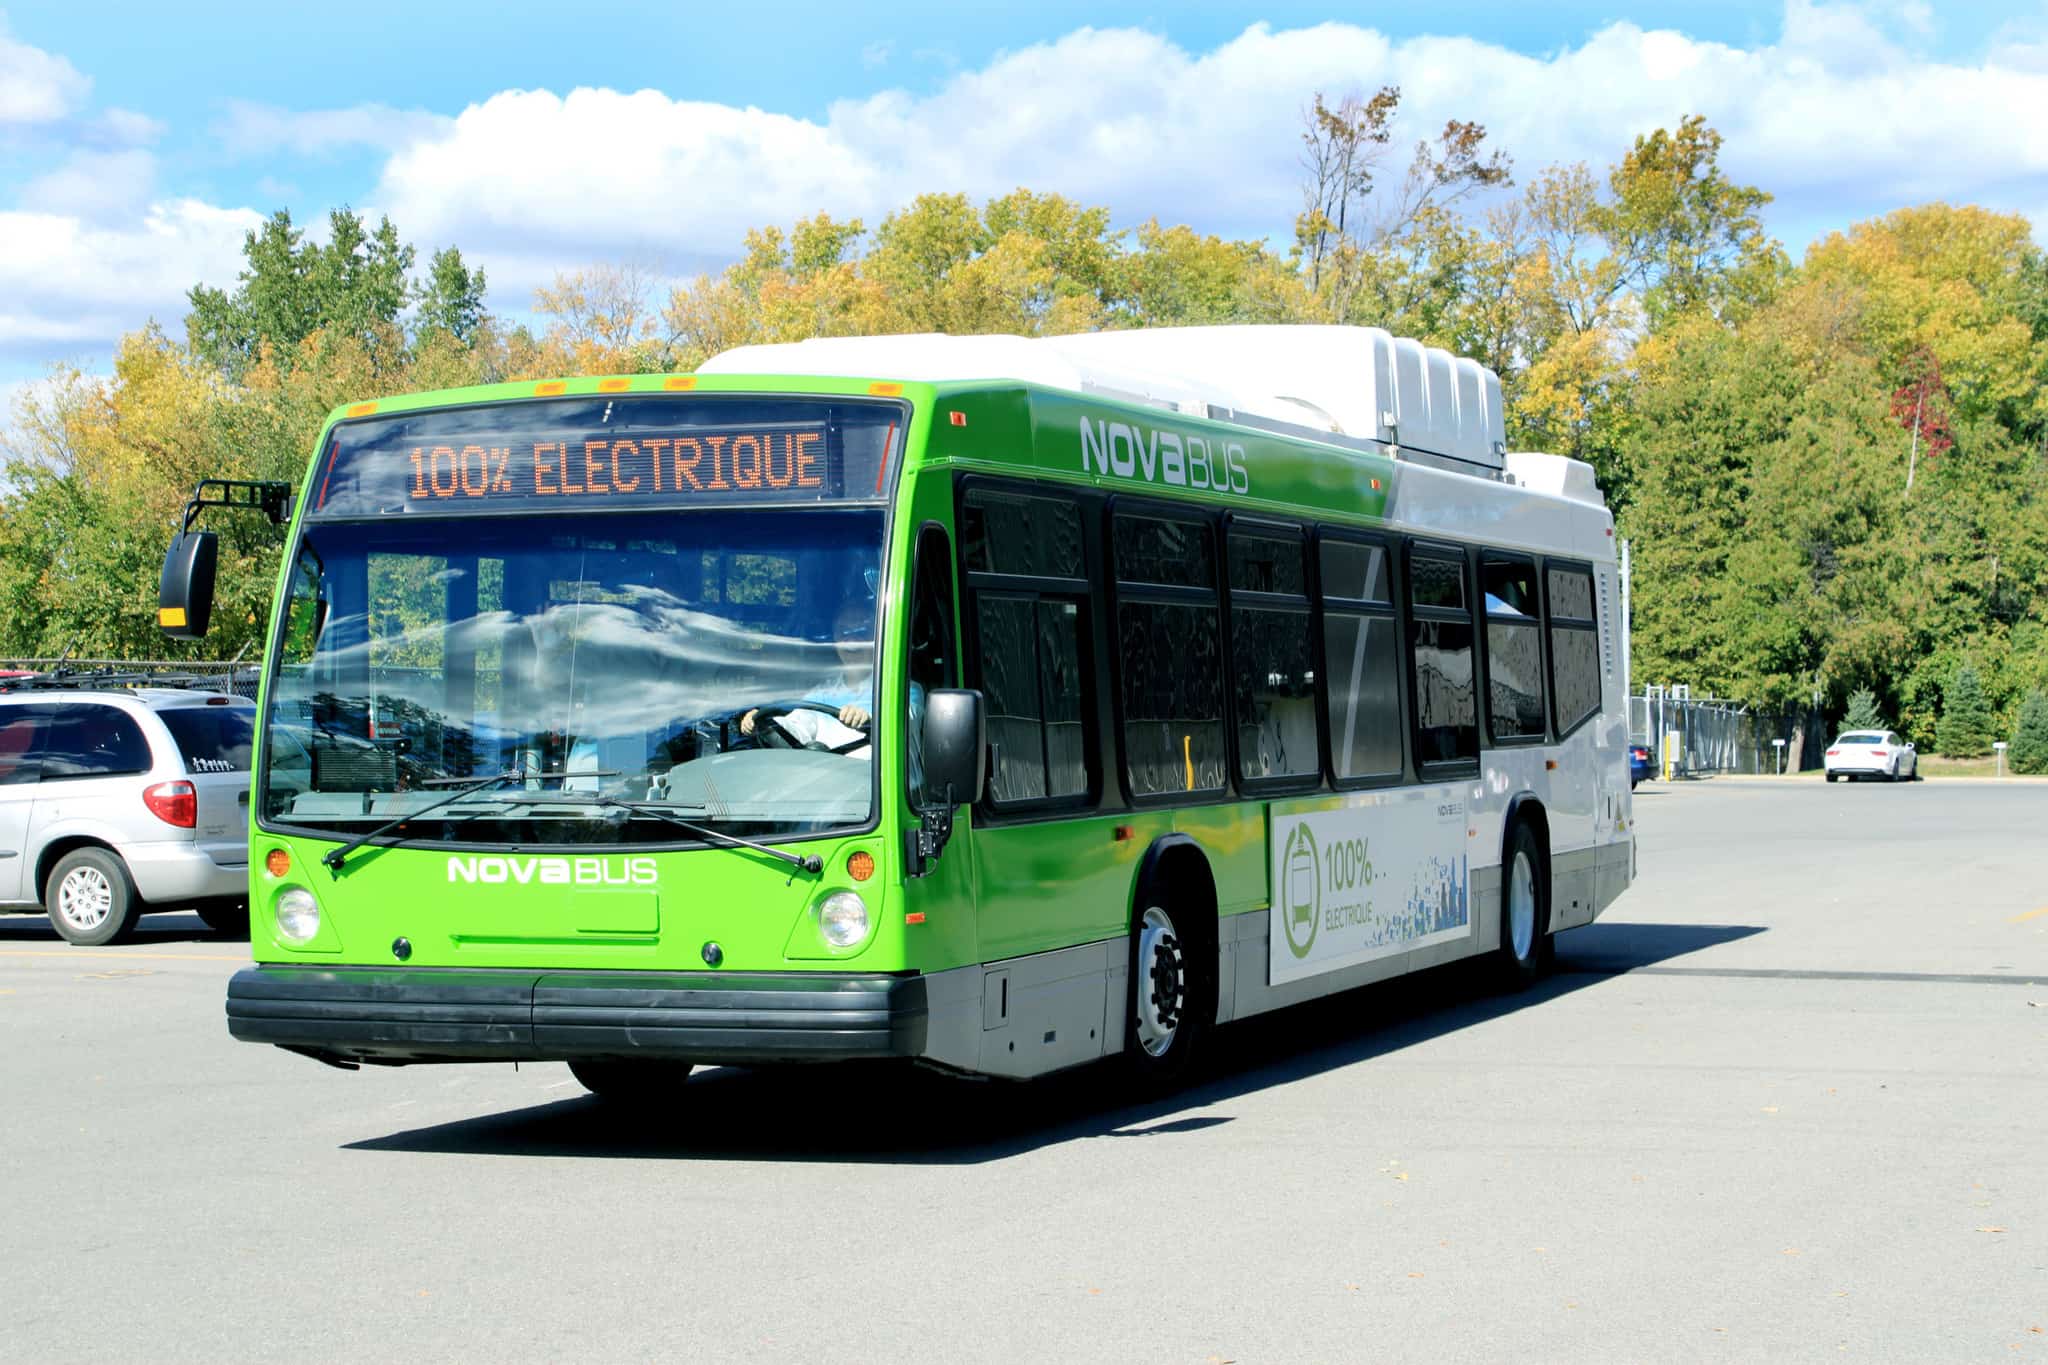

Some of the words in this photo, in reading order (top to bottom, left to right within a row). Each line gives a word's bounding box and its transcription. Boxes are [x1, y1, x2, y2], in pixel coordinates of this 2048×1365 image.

[408, 445, 511, 498] 100%
[533, 432, 823, 495] ELECTRIQUE
[1325, 837, 1373, 893] 100%
